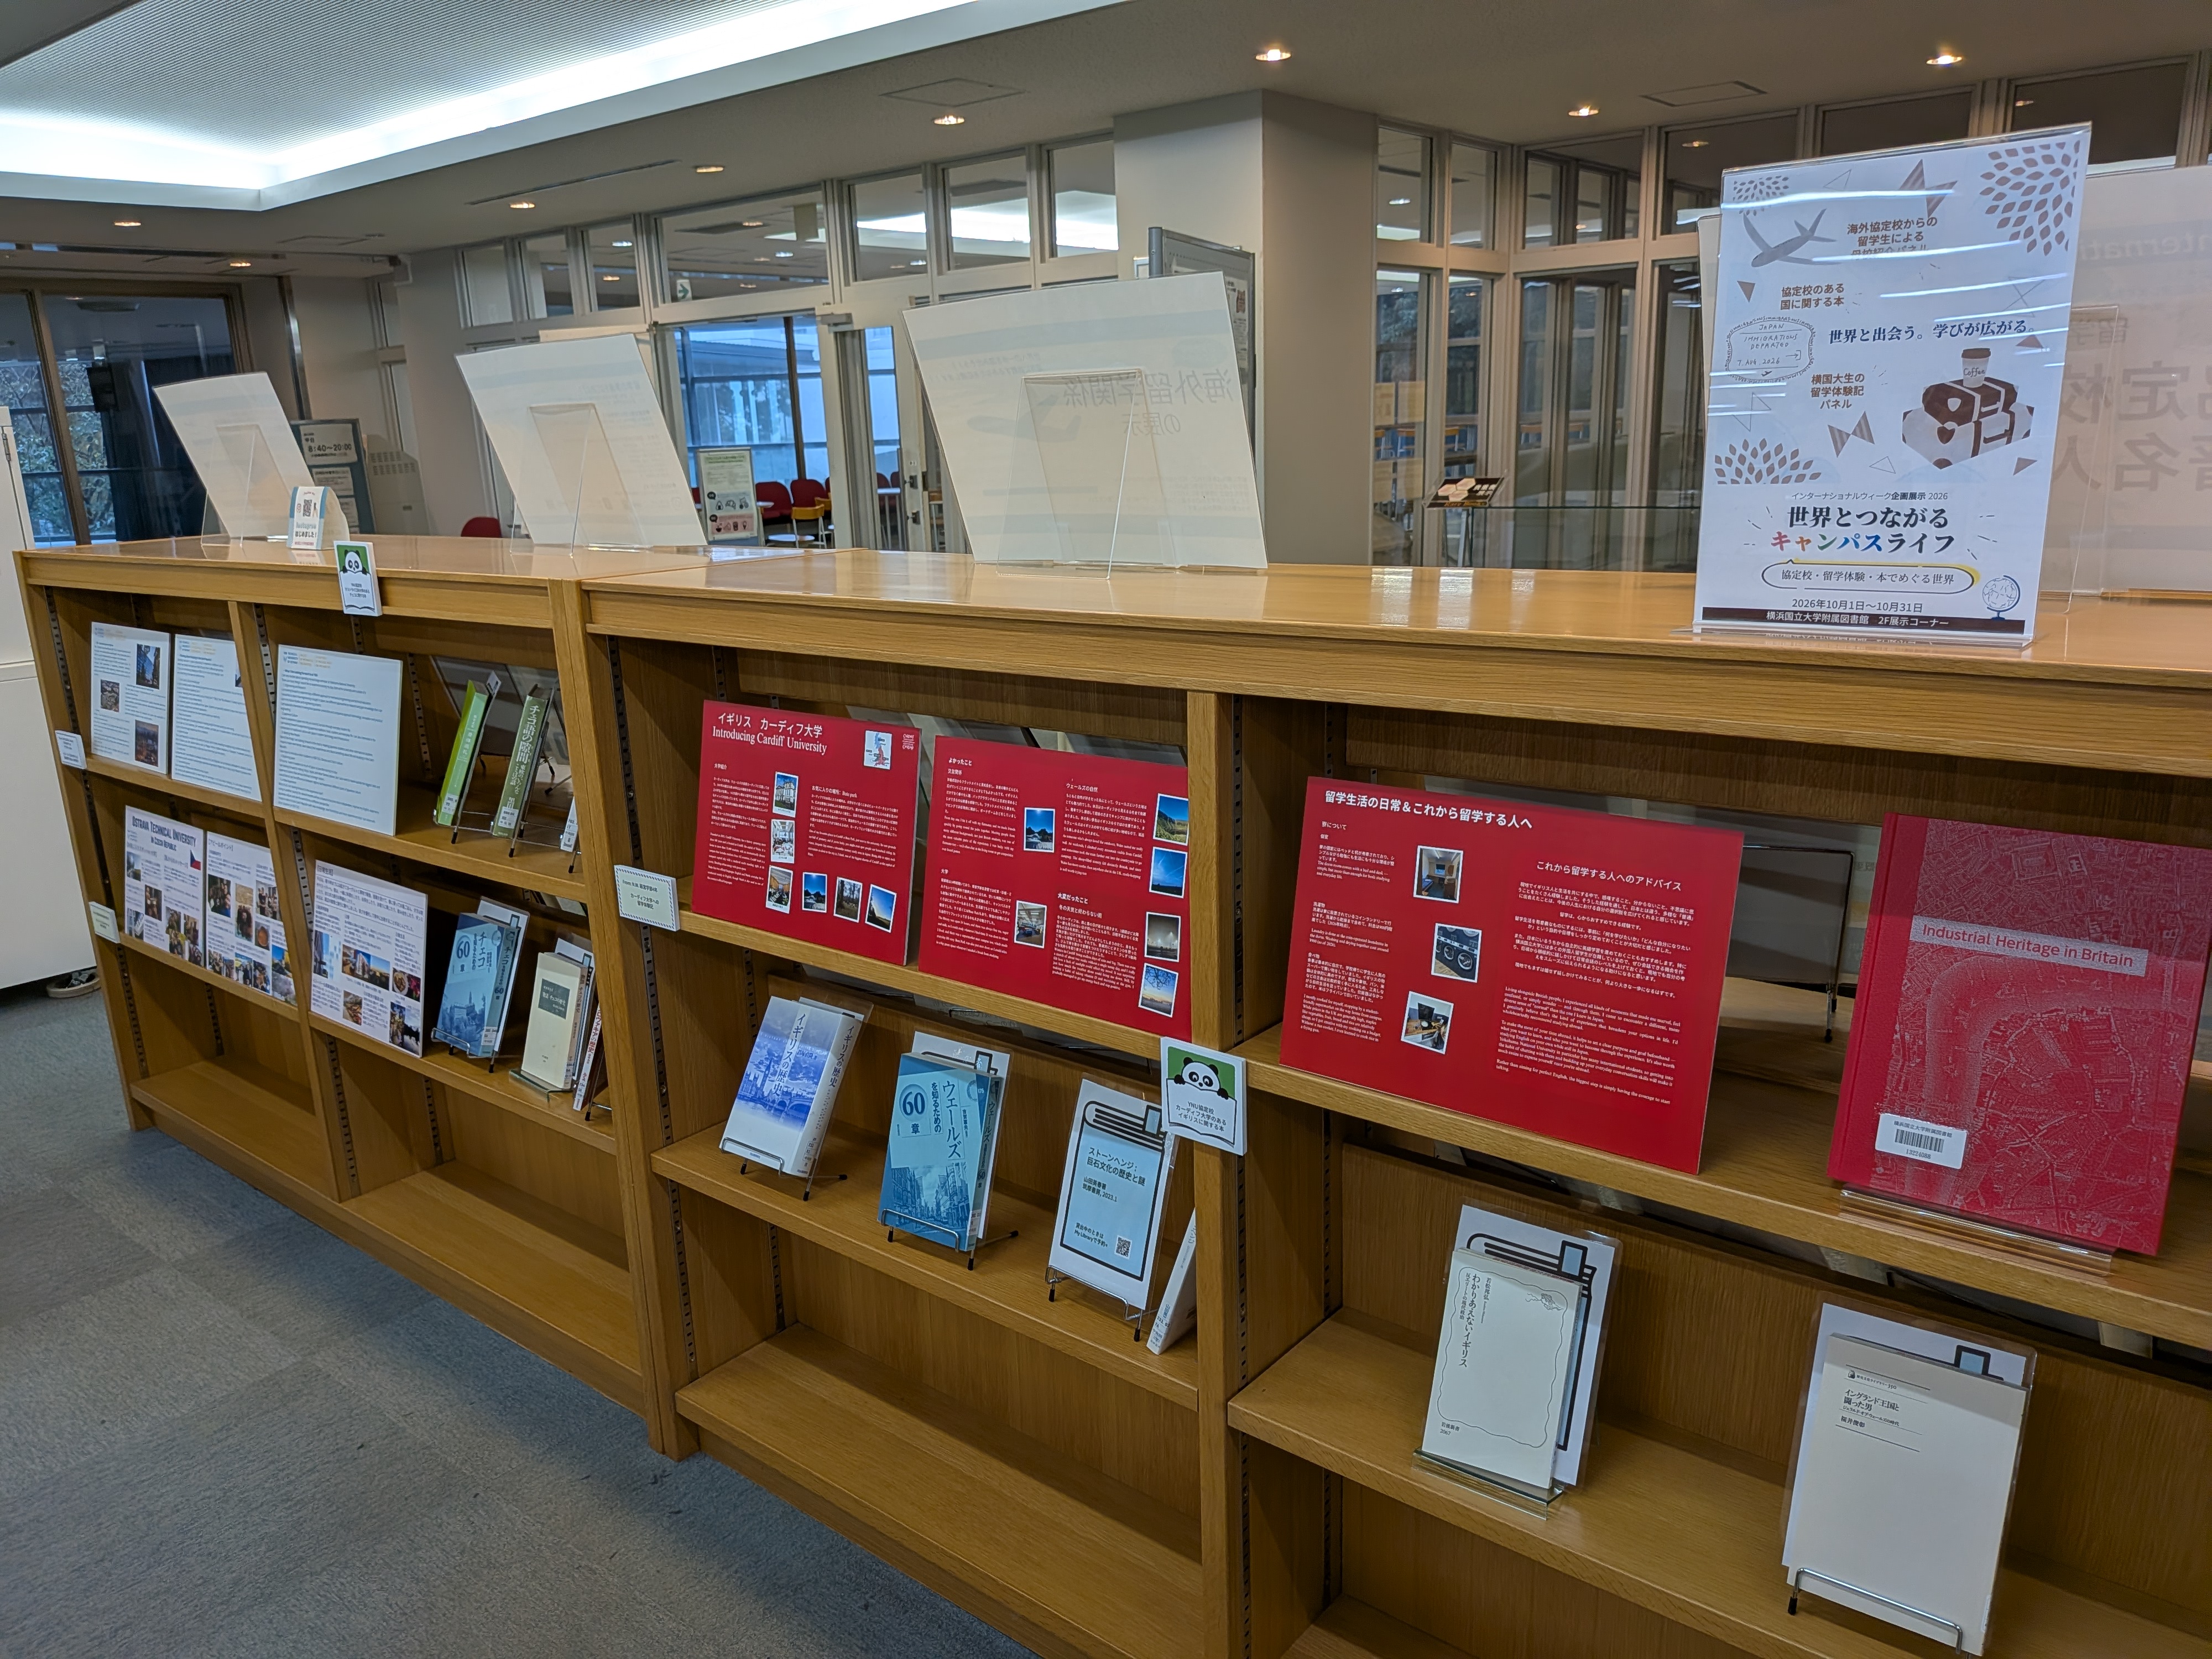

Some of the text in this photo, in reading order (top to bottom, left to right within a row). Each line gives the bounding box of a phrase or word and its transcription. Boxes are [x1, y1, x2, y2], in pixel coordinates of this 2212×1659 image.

[1847, 216, 1938, 236] 海外協定校からの
[1858, 231, 1924, 247] 留学生による
[1781, 283, 1845, 298] 協定校のある
[1780, 296, 1845, 311] 国に関する本
[1759, 322, 1785, 331] JAPAN
[1744, 333, 1798, 343] IMMIGRATIONS
[1811, 373, 1865, 385] 横国大生の
[1963, 366, 1986, 379] Coffee
[1811, 385, 1865, 398] 留学体験記
[1819, 399, 1853, 410] パネル
[1791, 491, 1949, 502] インターナショナルウィーク企画展示 2026
[1787, 506, 1950, 530] 世界とつながる
[1770, 530, 1956, 554] キャンパスライフ
[1781, 568, 1955, 587] 協定校・留学体験・本でめぐる世界
[1766, 610, 1950, 628] 横浜国立大学附属図書館 2F展示コーナー
[718, 711, 823, 739] イギリス カーディフ大学
[712, 726, 827, 756] Introducing Cardiff University
[948, 757, 973, 766] よかったこと
[132, 816, 197, 847] OSTRAVA TECHNICAL UNIVERSITY
[1537, 861, 1681, 890] これから留学する人へのアドバイス
[456, 940, 470, 959] 60
[478, 931, 487, 968] チェコ
[1922, 924, 2134, 968] Industrial Heritage in Britain
[772, 1013, 807, 1097] イギリスの歴史
[828, 1025, 855, 1088] イギリスの歴史
[902, 1091, 926, 1117] 60
[931, 1081, 942, 1134] を知るための
[1187, 1100, 1214, 1115] YNU協定校
[942, 1079, 963, 1159] ウェールズ
[1176, 1104, 1227, 1126] カーディフ大学のある
[1178, 1112, 1225, 1133] イギリスに関する本
[910, 1123, 921, 1135] 章
[1086, 1156, 1146, 1187] 巨石文化の歴史と謎
[1458, 1273, 1481, 1368] わかりあえないイギリス
[1844, 1396, 1873, 1412] 闘った男
[1845, 1389, 1901, 1412] イングランド王国と
[1439, 1428, 1452, 1437] 2067
